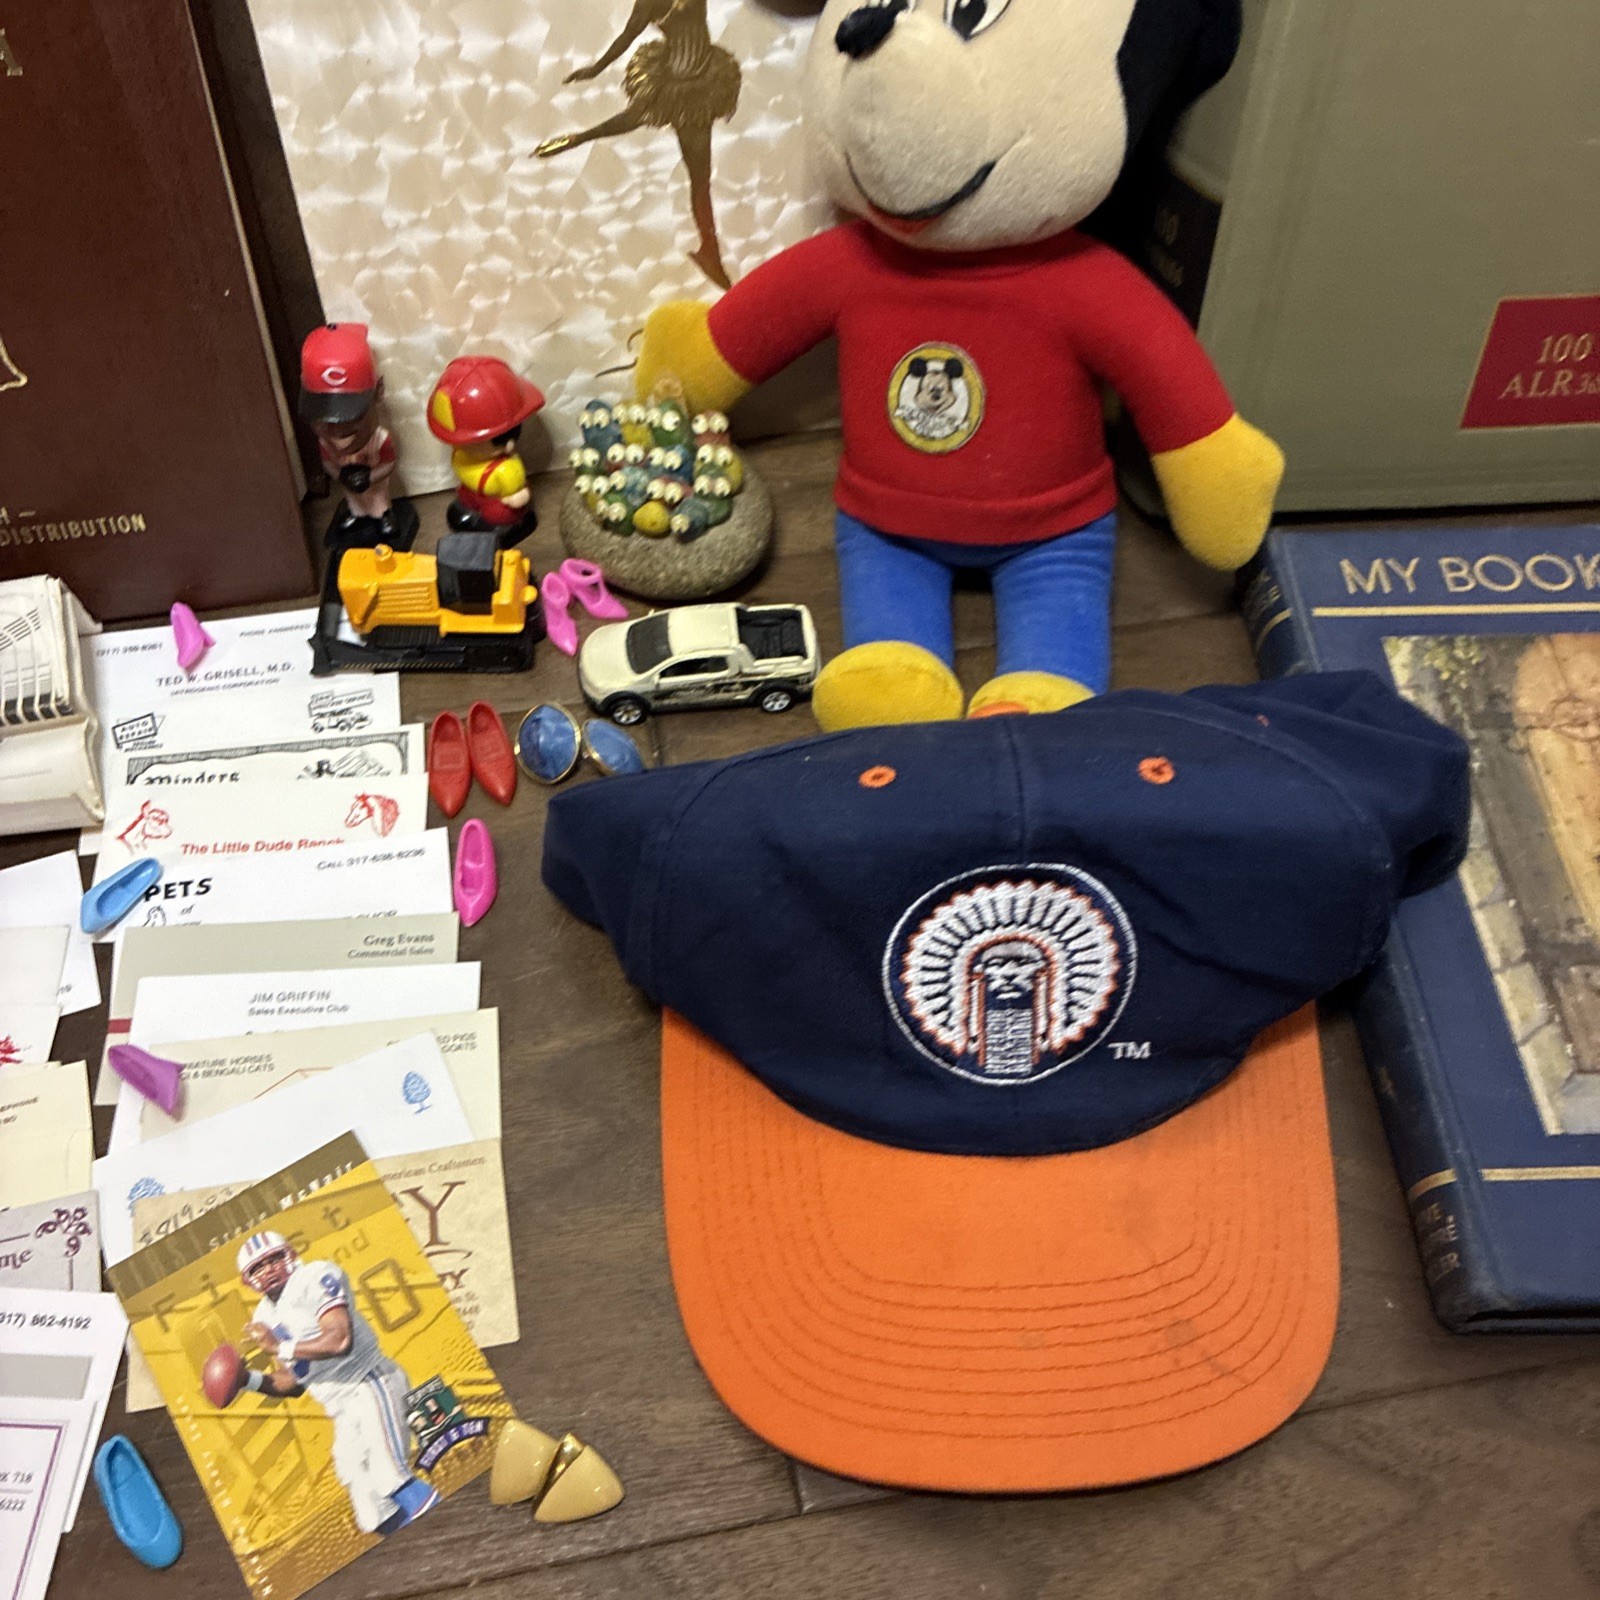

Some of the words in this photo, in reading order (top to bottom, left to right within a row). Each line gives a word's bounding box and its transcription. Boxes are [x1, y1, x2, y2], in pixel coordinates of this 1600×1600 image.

[1537, 333, 1594, 363] 100
[321, 366, 348, 386] C
[1338, 557, 1421, 594] MY
[1438, 553, 1600, 593] BOOK
[157, 676, 183, 688] TED
[204, 665, 265, 681] GRISELL,
[267, 661, 296, 673] M.D.
[181, 843, 208, 856] The
[211, 841, 250, 855] Little
[253, 839, 294, 853] Dude
[142, 877, 214, 903] PETS
[363, 934, 395, 948] Greg
[397, 933, 435, 945] Evans
[347, 948, 408, 959] Commercial
[248, 991, 274, 1004] JIM
[276, 989, 331, 1003] GRIFFIN
[248, 1007, 275, 1016] Sales
[277, 1004, 324, 1015] Executive
[1107, 1041, 1152, 1060] TM
